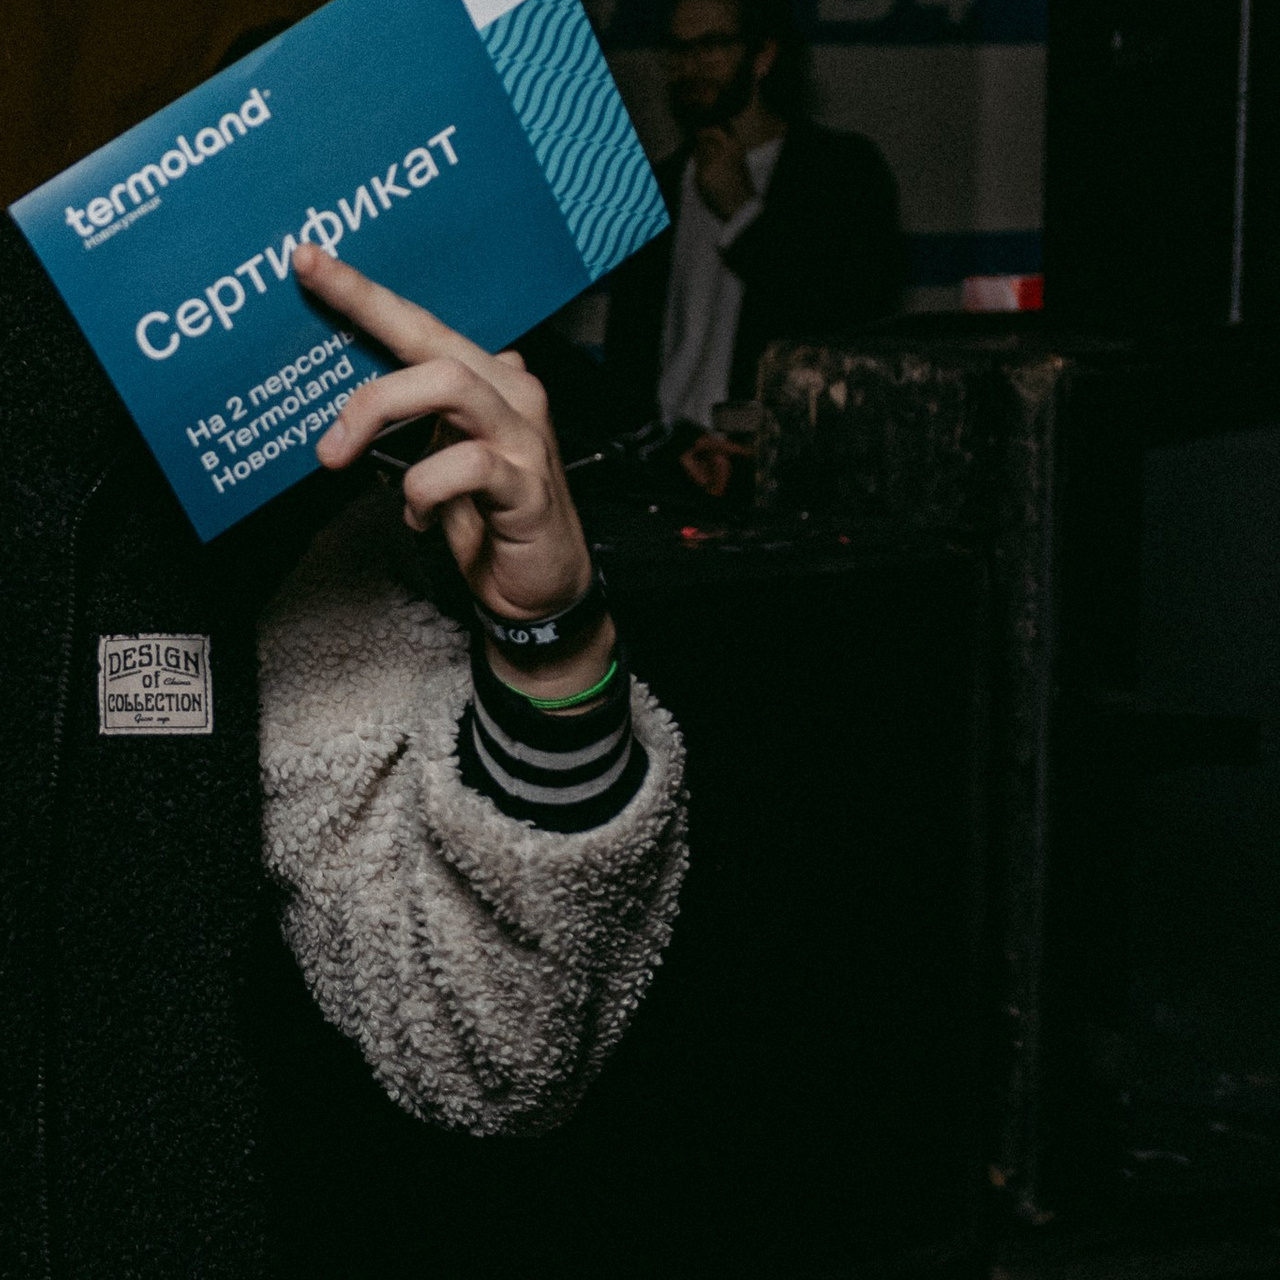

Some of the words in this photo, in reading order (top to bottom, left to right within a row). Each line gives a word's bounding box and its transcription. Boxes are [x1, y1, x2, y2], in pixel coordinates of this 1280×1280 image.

[65, 88, 271, 237] termoland
[135, 125, 458, 361] Сертификат
[186, 414, 227, 448] На
[226, 396, 248, 421] 2
[201, 451, 220, 470] в
[218, 354, 355, 454] Termoland
[211, 371, 378, 494] Новокузне
[109, 643, 200, 676] DESIGN
[142, 671, 161, 688] of
[107, 693, 202, 713] COLLECTION
